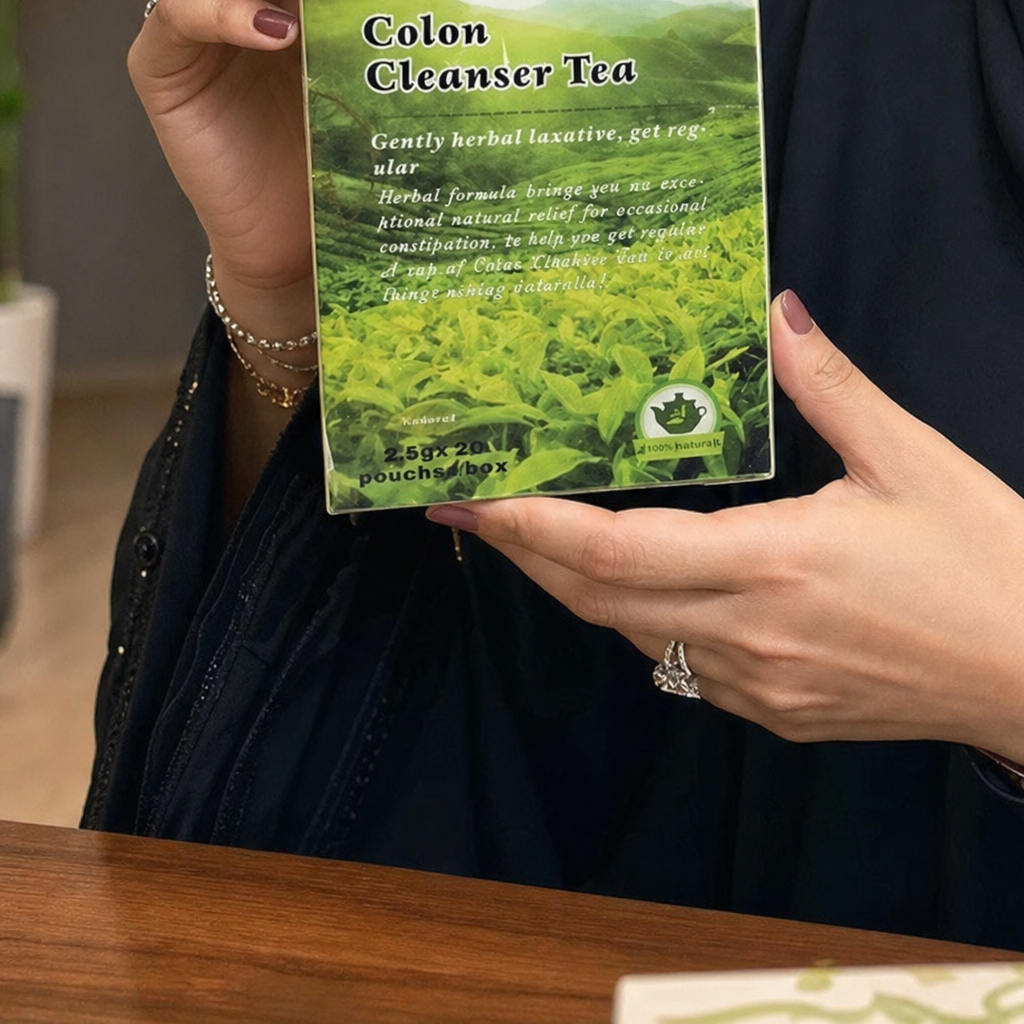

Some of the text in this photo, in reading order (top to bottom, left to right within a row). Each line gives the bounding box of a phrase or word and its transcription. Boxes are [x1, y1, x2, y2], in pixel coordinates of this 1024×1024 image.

[362, 13, 489, 48] Colon
[365, 53, 637, 93] Cleanser Tea
[371, 132, 445, 154] Gently
[452, 128, 522, 148] herbal
[529, 125, 623, 143] laxative,
[630, 124, 661, 144] get
[373, 159, 420, 176] ular
[378, 188, 440, 205] Herbal
[445, 185, 517, 207] formula
[451, 208, 520, 226] natural
[528, 204, 579, 224] relief
[579, 203, 609, 224] for
[608, 226, 636, 246] get
[454, 440, 484, 456] 20
